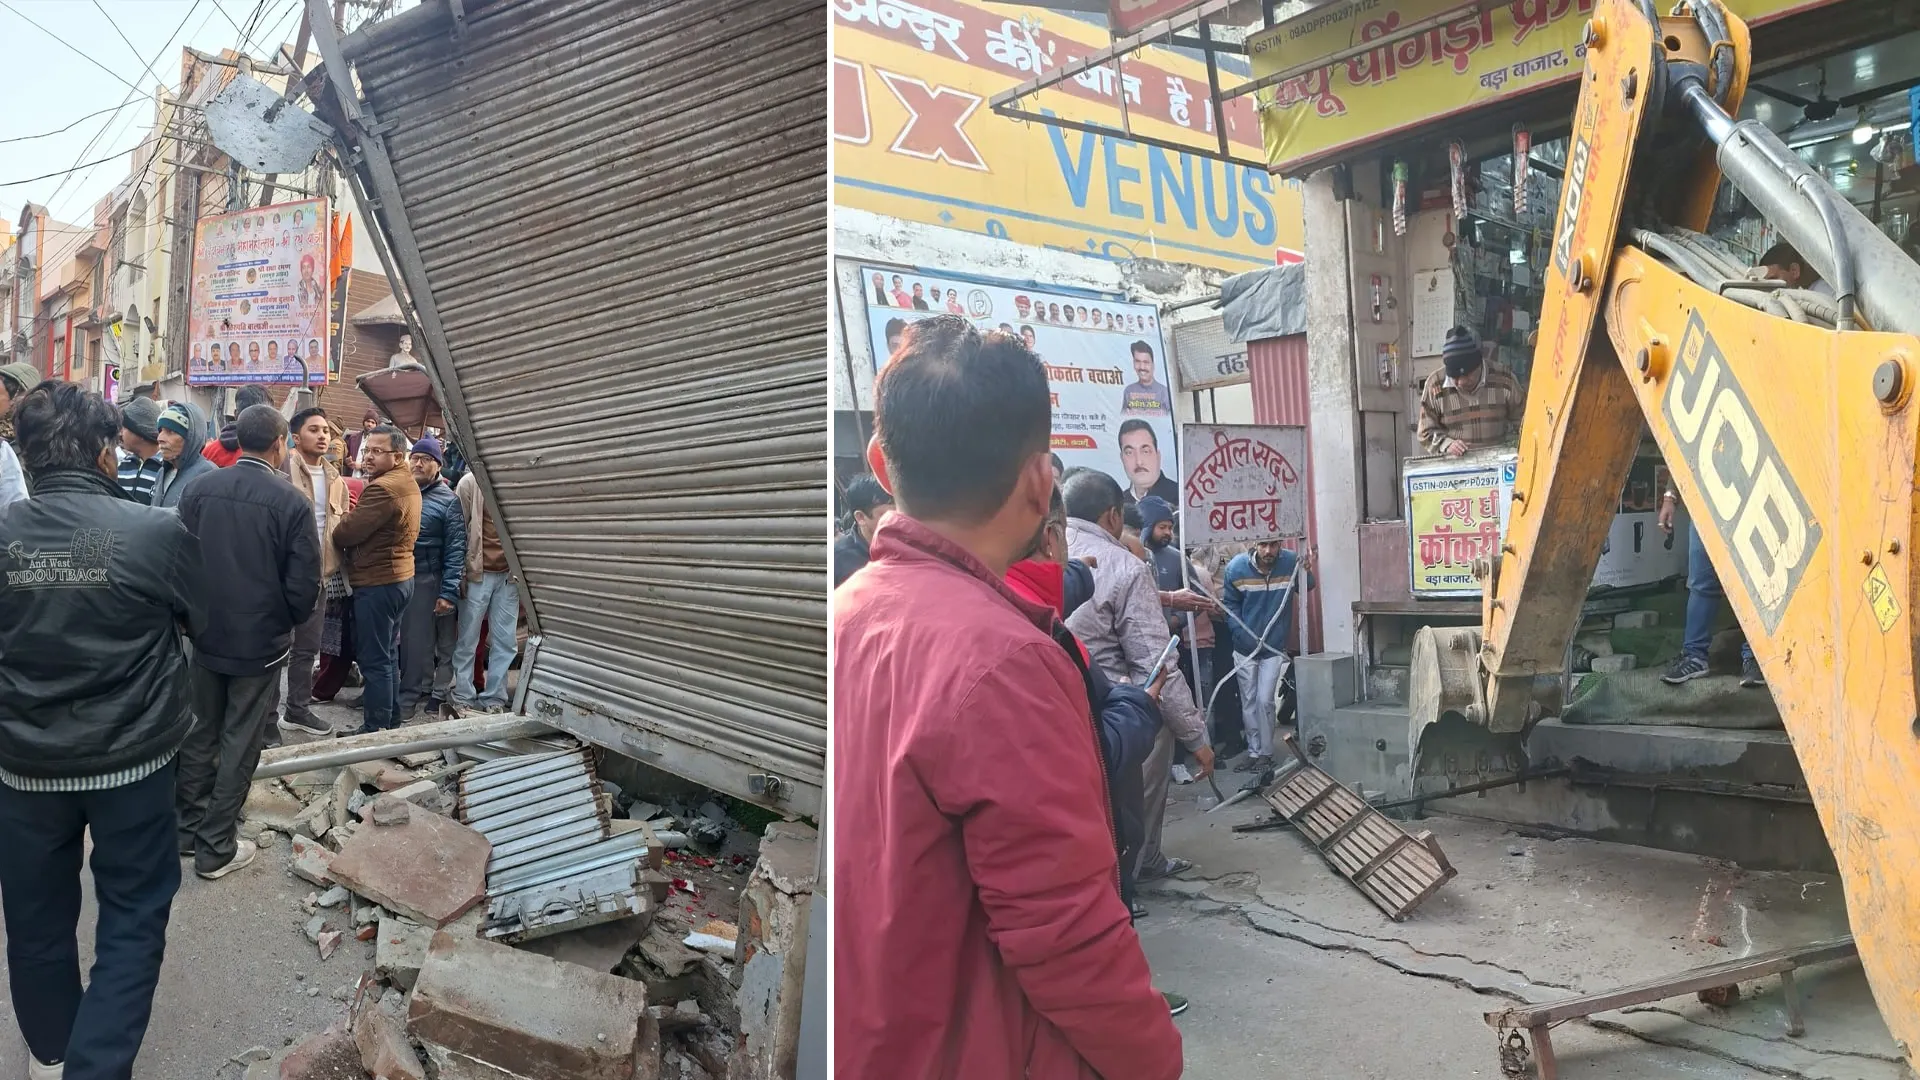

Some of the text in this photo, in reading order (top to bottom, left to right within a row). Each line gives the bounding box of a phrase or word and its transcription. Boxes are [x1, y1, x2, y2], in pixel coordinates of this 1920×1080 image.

[1254, 35, 1281, 53] GSTIN
[1480, 67, 1508, 89] बड़ा
[1512, 49, 1569, 77] बाजार,
[1040, 107, 1277, 247] VENUS
[1086, 365, 1124, 386] बचाओ
[1215, 351, 1249, 375] तह
[1185, 431, 1299, 508] तहसील सदर
[1669, 354, 1807, 611] JCB
[1441, 497, 1475, 525] न्यू
[7, 568, 108, 585] INDOUTBACK
[29, 559, 47, 569] And
